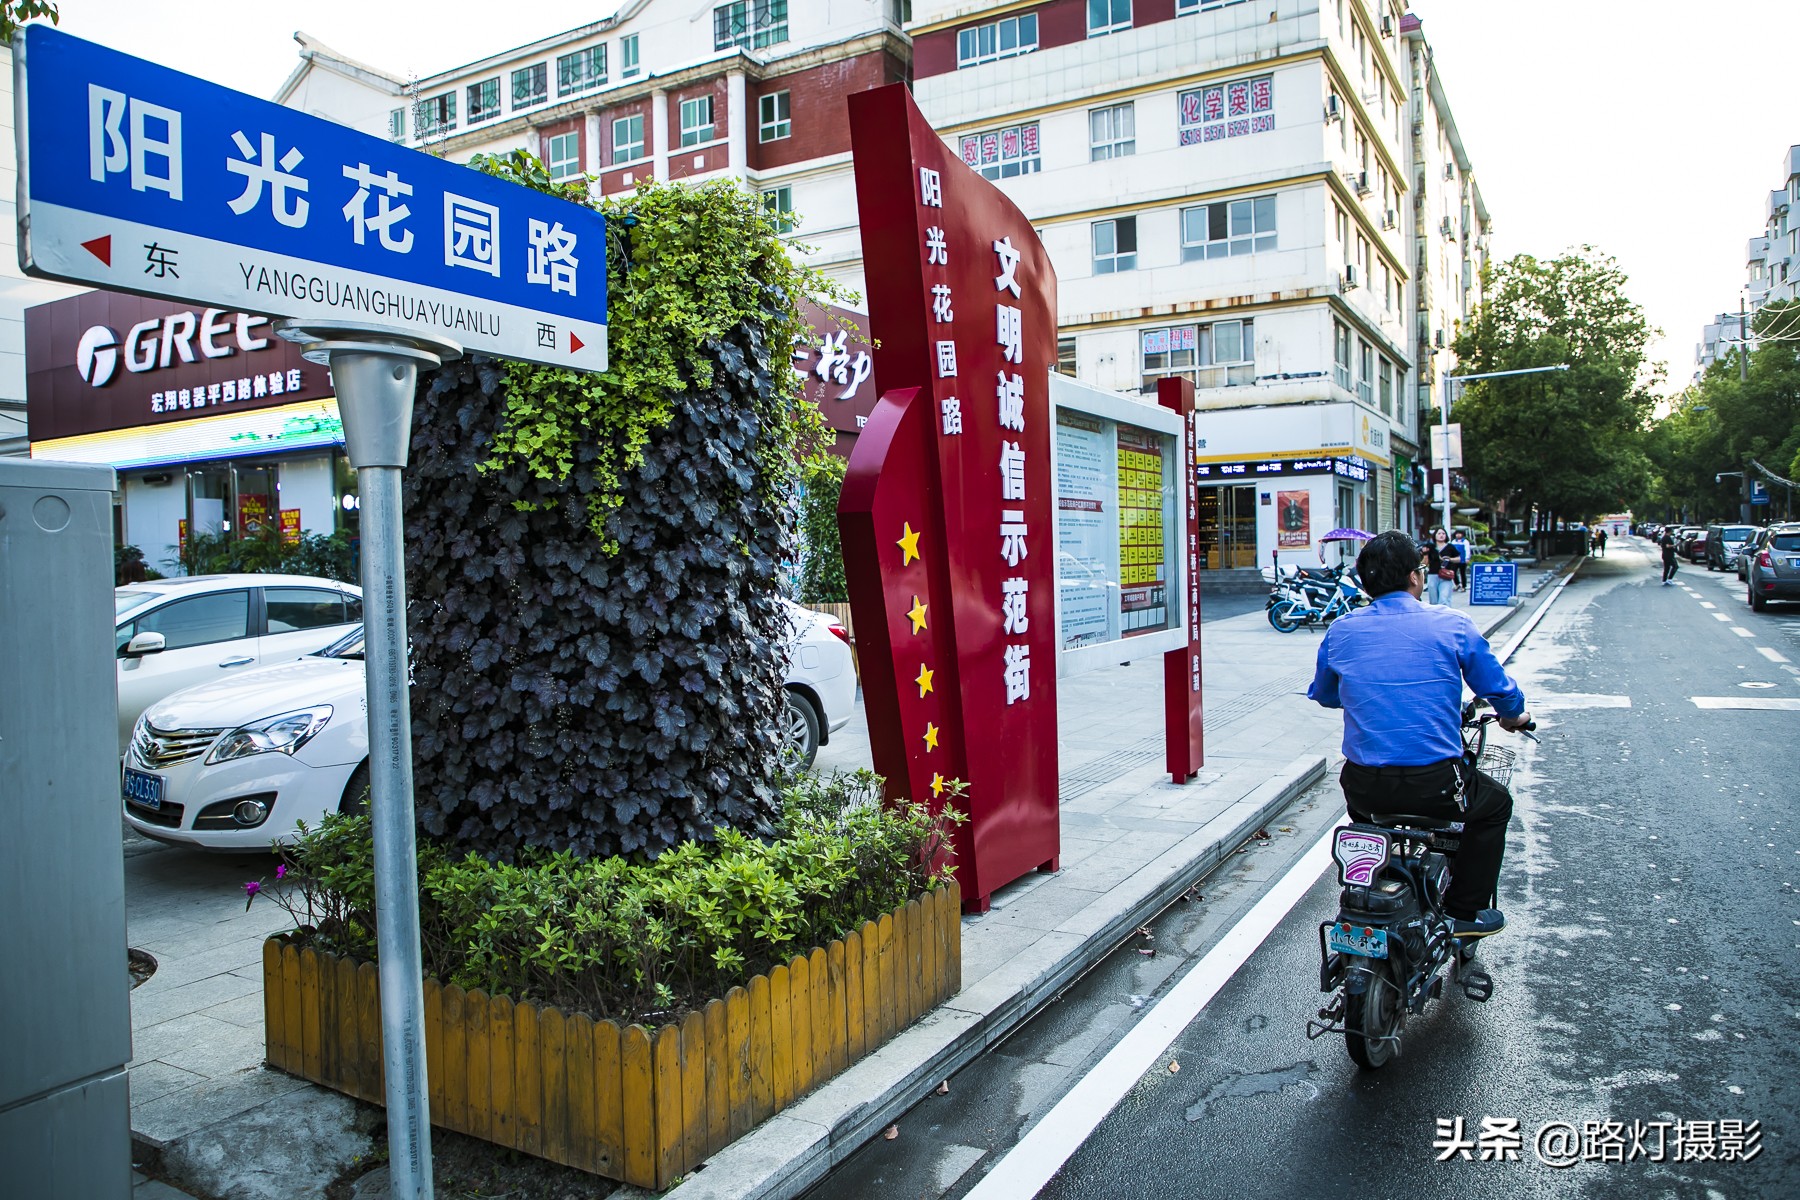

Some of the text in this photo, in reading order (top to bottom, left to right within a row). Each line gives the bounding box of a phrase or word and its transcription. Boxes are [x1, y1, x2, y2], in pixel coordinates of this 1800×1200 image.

[1183, 80, 1271, 124] 化学英语
[963, 125, 1039, 164] 数学物理
[88, 82, 580, 298] 阳光花园路
[143, 242, 180, 280] 东
[239, 262, 501, 338] YANGGUANGHUAYUANLU
[919, 166, 963, 436] 阳光花园路
[536, 321, 557, 350] 西
[151, 368, 302, 413] 宏翔电器平西路体验店
[992, 236, 1031, 706] 文明诚信示范街
